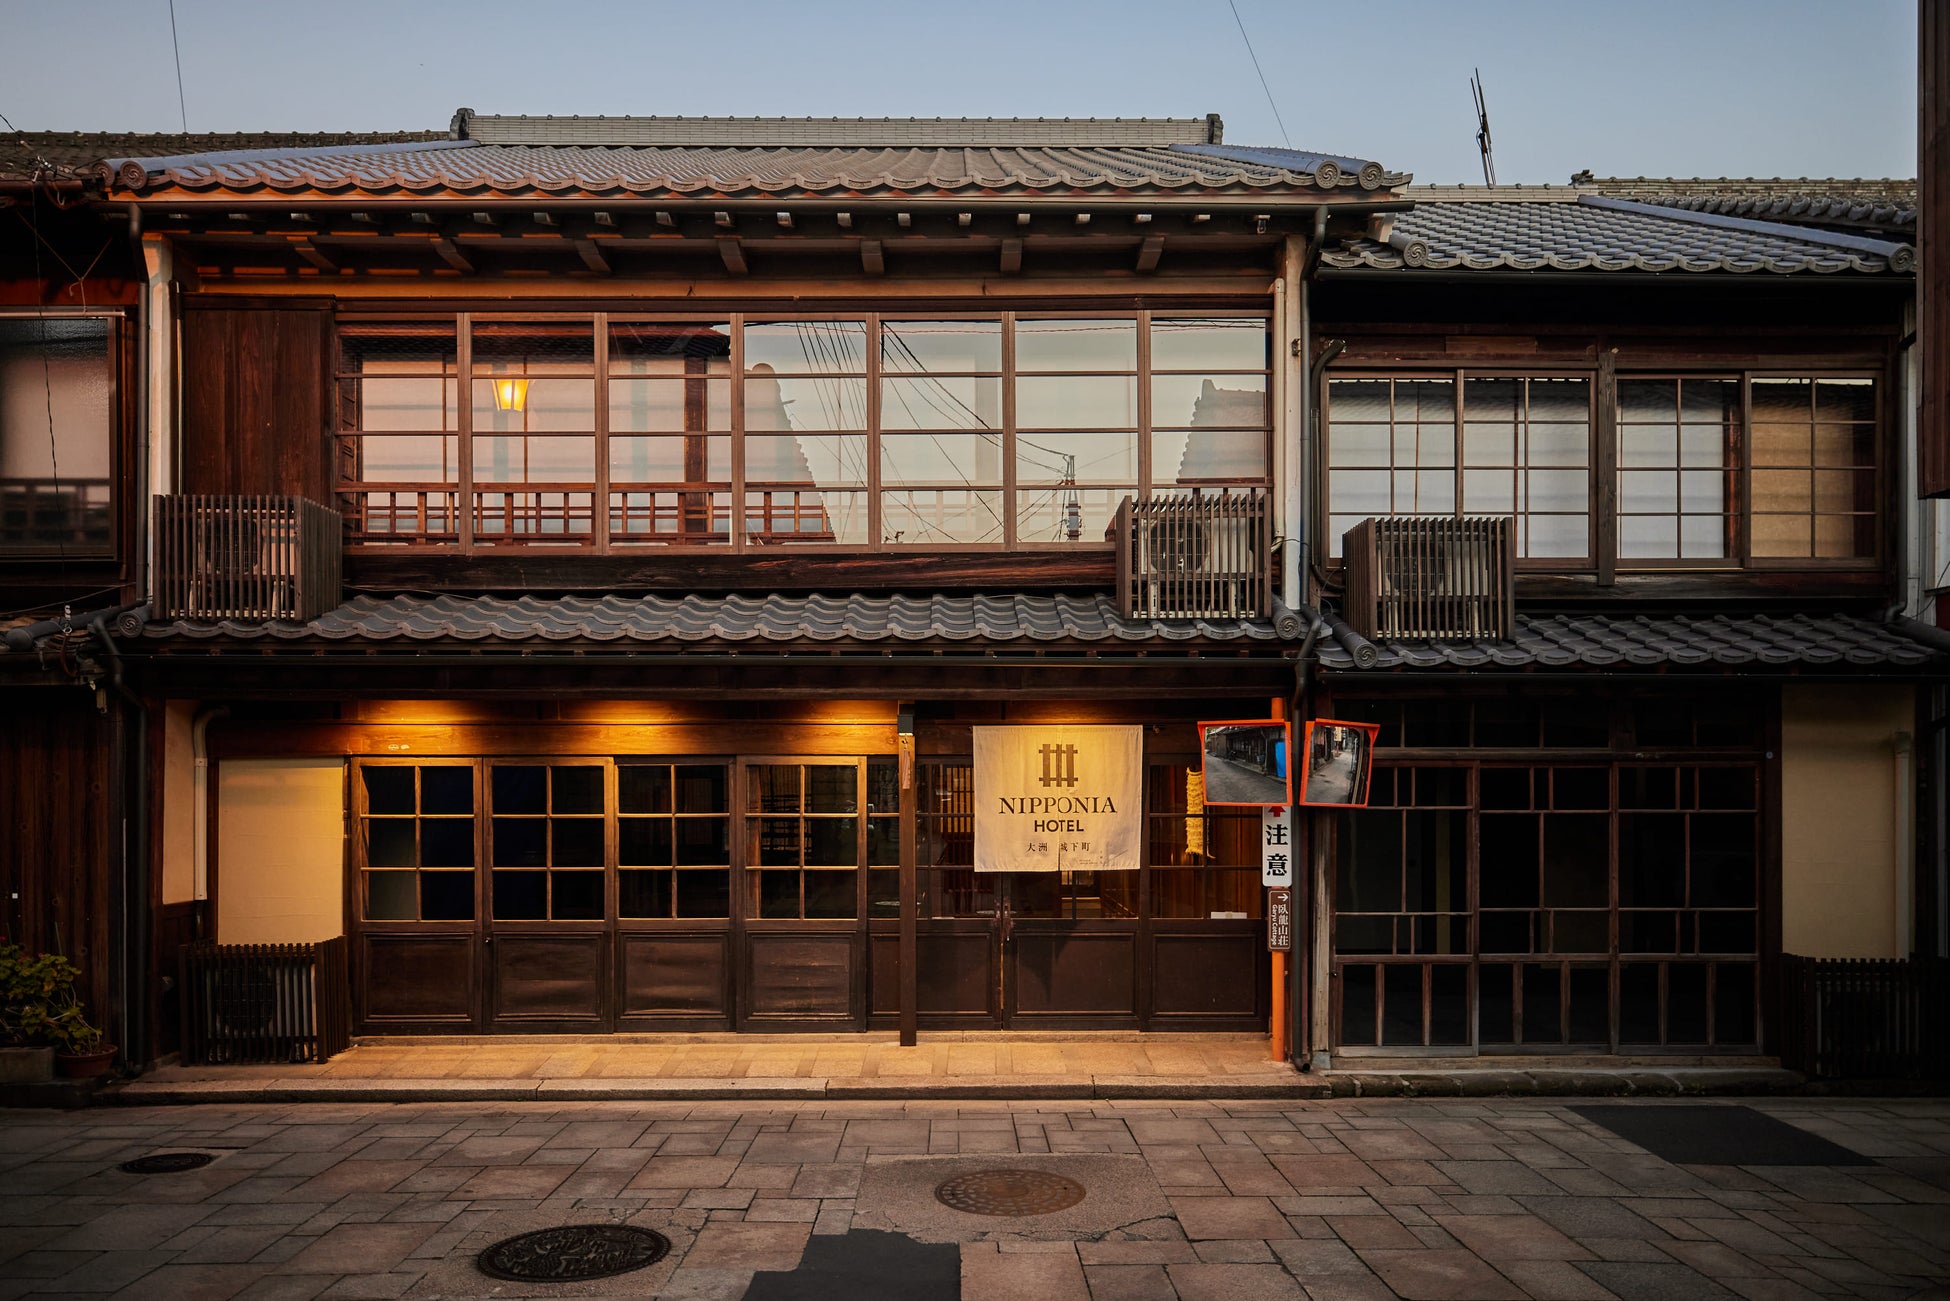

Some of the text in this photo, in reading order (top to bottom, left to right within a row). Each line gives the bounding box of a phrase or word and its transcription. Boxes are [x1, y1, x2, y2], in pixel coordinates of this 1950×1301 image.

[999, 797, 1117, 814] NIPPONIA
[1034, 819, 1084, 832] HOTEL
[1027, 842, 1048, 852] 大洲
[1265, 824, 1288, 876] 注意
